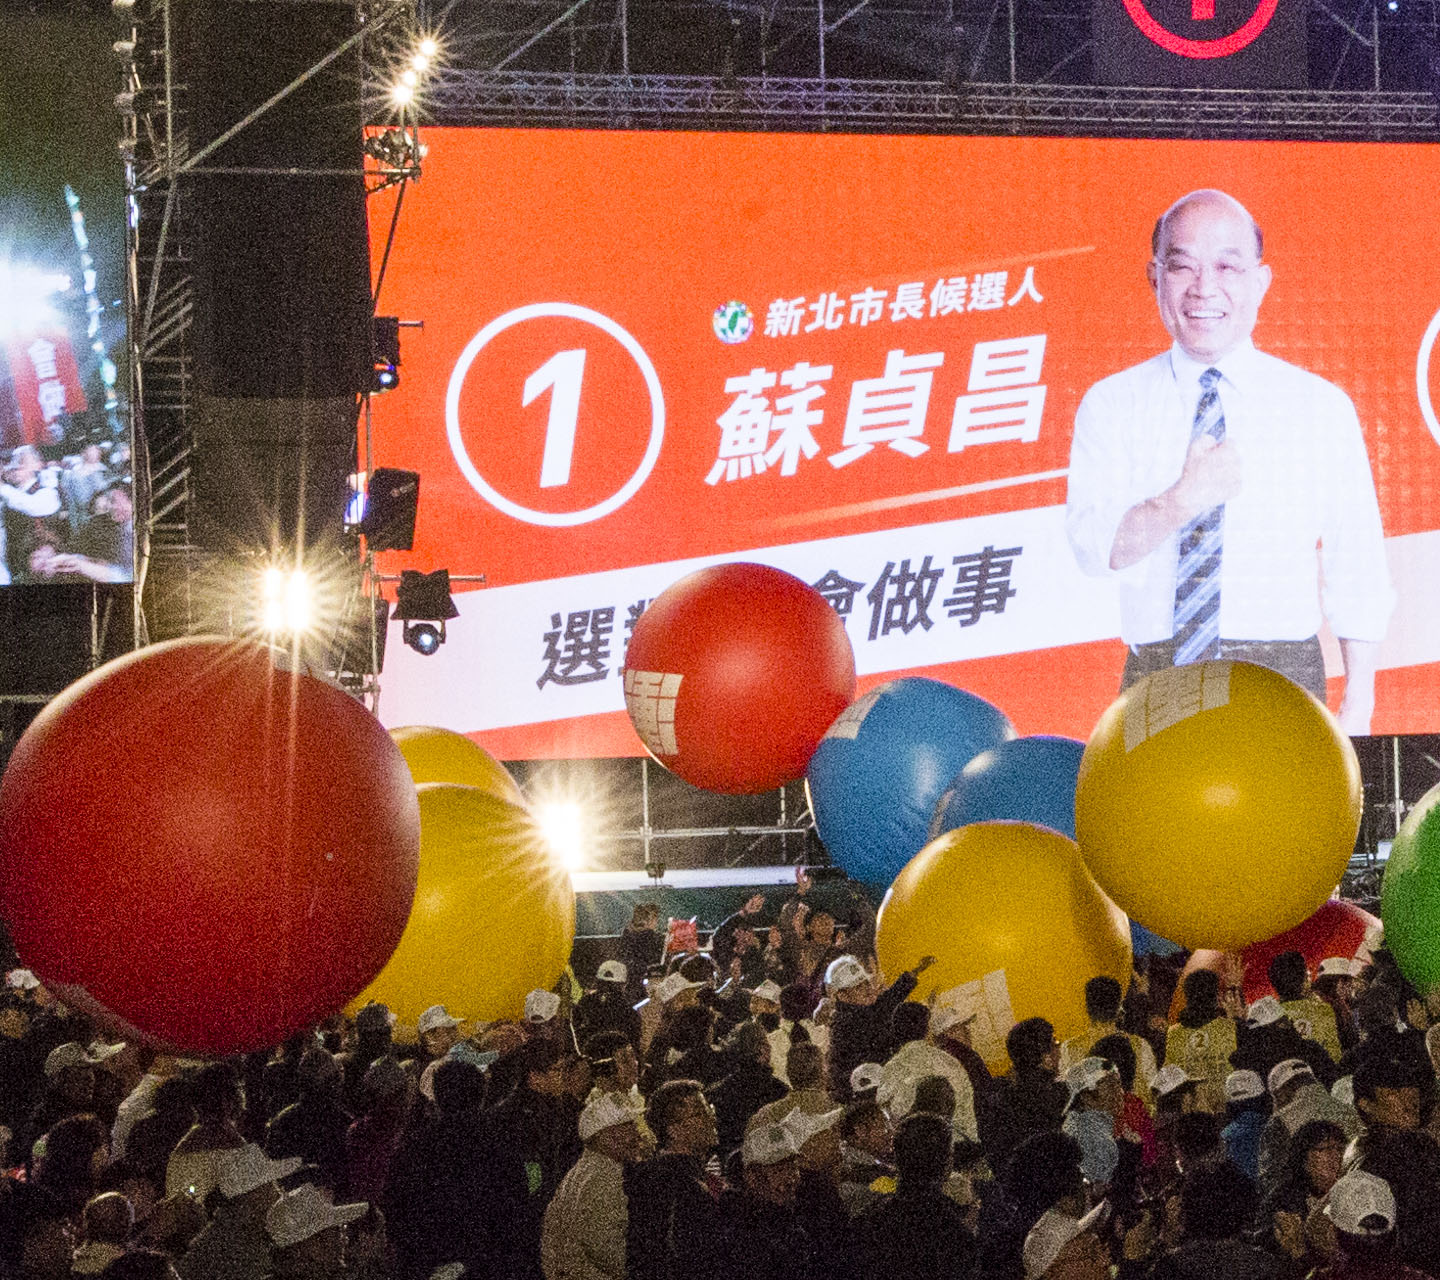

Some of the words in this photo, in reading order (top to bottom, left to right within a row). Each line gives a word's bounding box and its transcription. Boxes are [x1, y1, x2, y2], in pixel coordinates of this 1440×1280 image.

[763, 266, 1044, 339] 新北市長候選人
[704, 334, 1047, 486] 蘇貞昌
